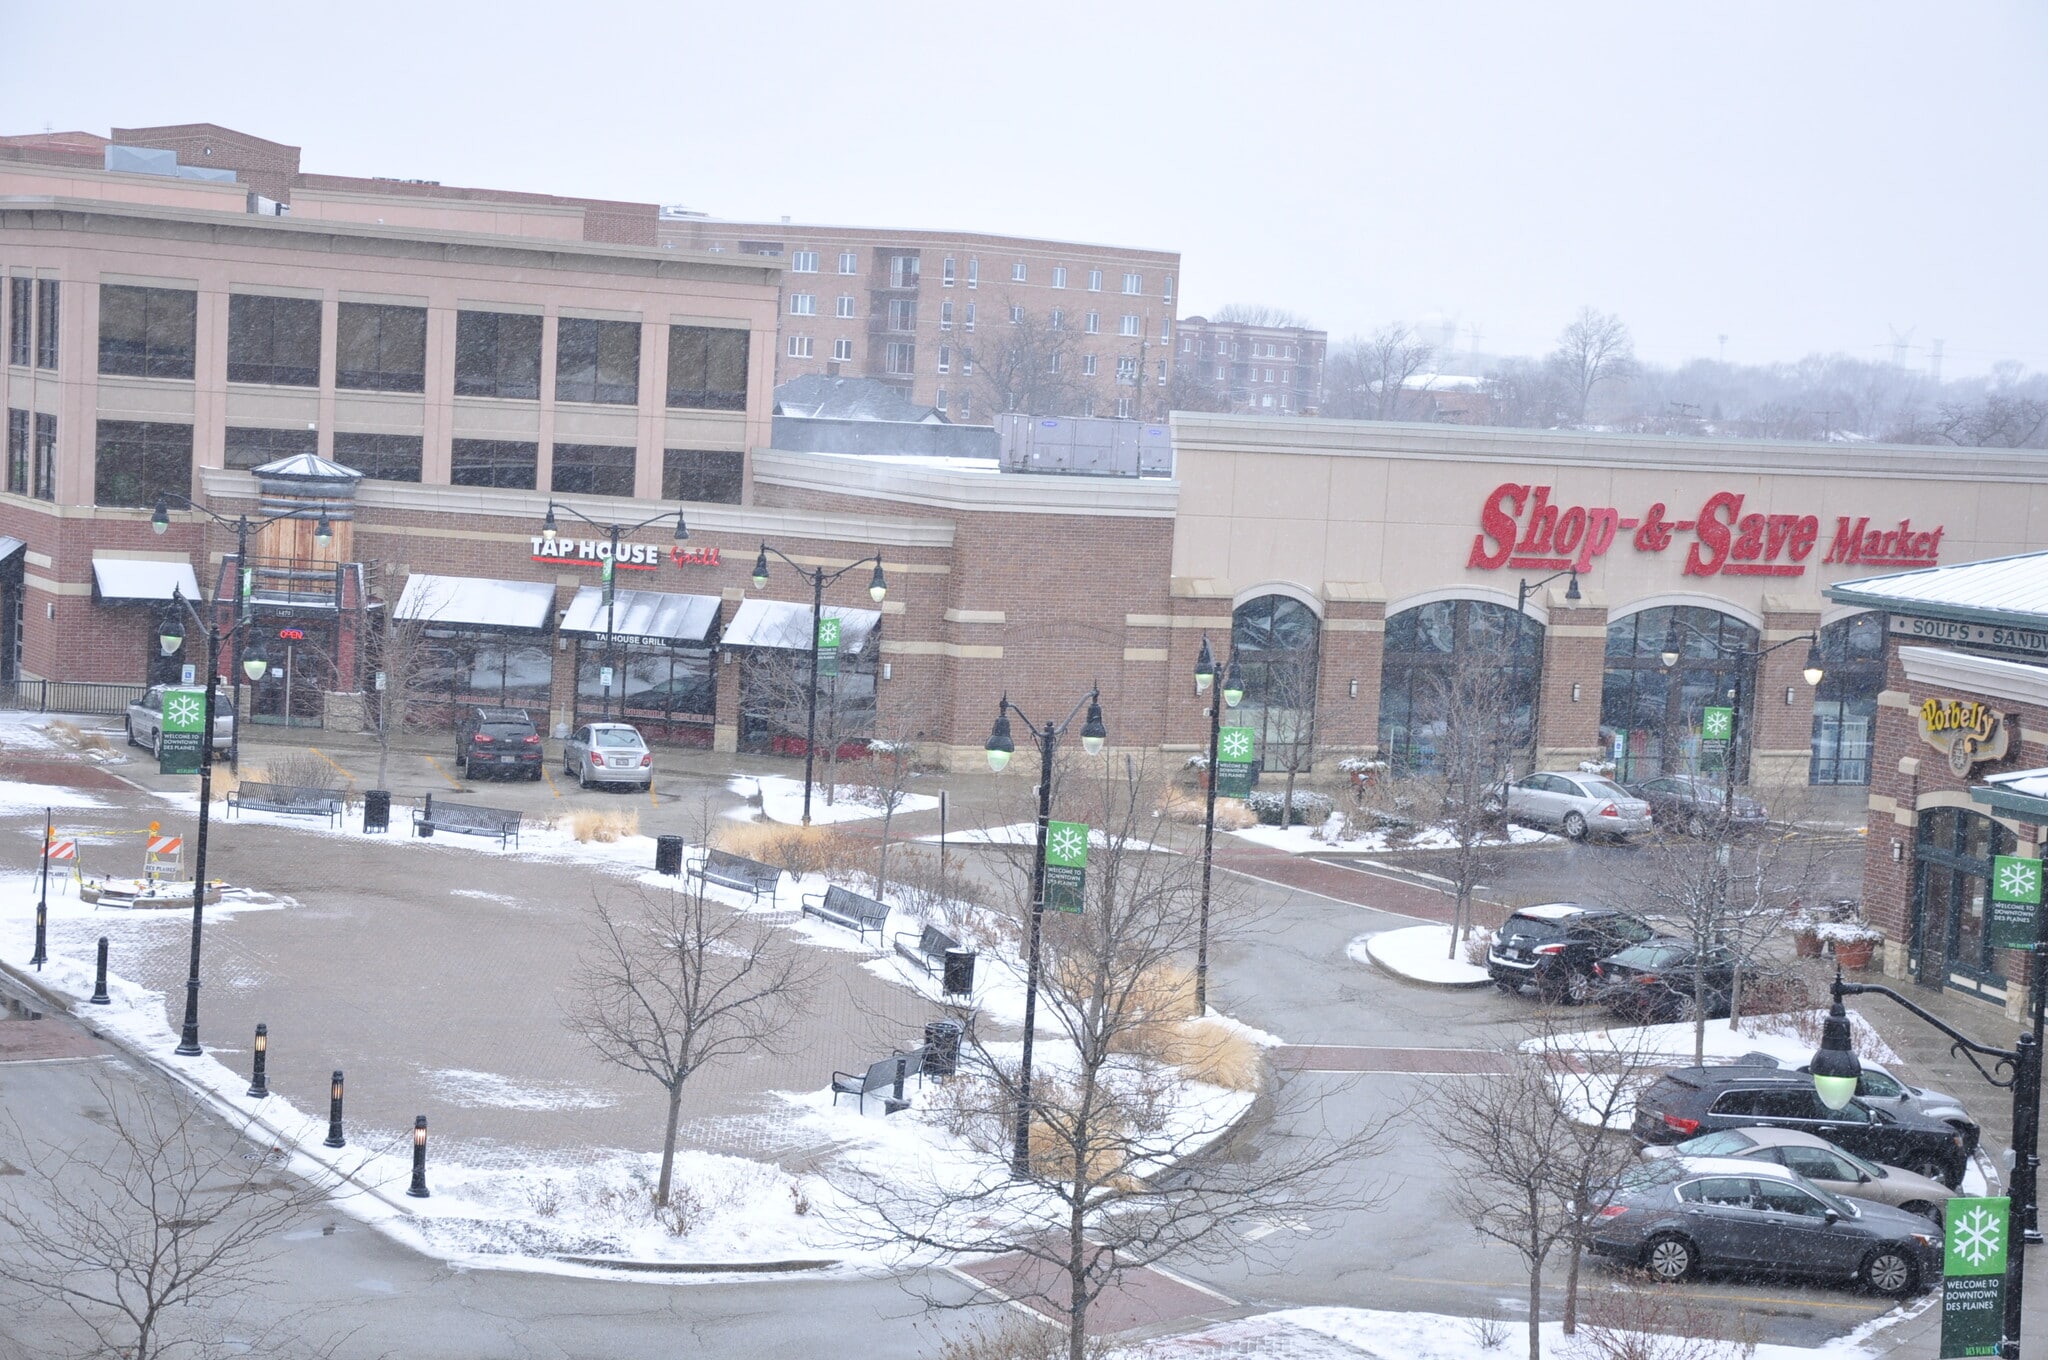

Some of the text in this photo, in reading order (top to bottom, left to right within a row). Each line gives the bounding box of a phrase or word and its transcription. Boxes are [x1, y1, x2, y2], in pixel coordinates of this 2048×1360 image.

[1823, 515, 1945, 566] Market
[530, 536, 720, 569] TAP HOUSE Grill
[280, 630, 303, 640] OPEN
[1912, 619, 1970, 640] SOUPS
[611, 634, 640, 645] HOUSE
[642, 636, 666, 647] GRILL
[1921, 698, 1994, 753] Potbelly
[1994, 909, 2034, 917] DOWNTOWN
[1947, 1279, 1999, 1289] WELCOME TO
[1946, 1290, 1998, 1300] DOWNTOWN
[1946, 1301, 1994, 1311] DES PLAINES
